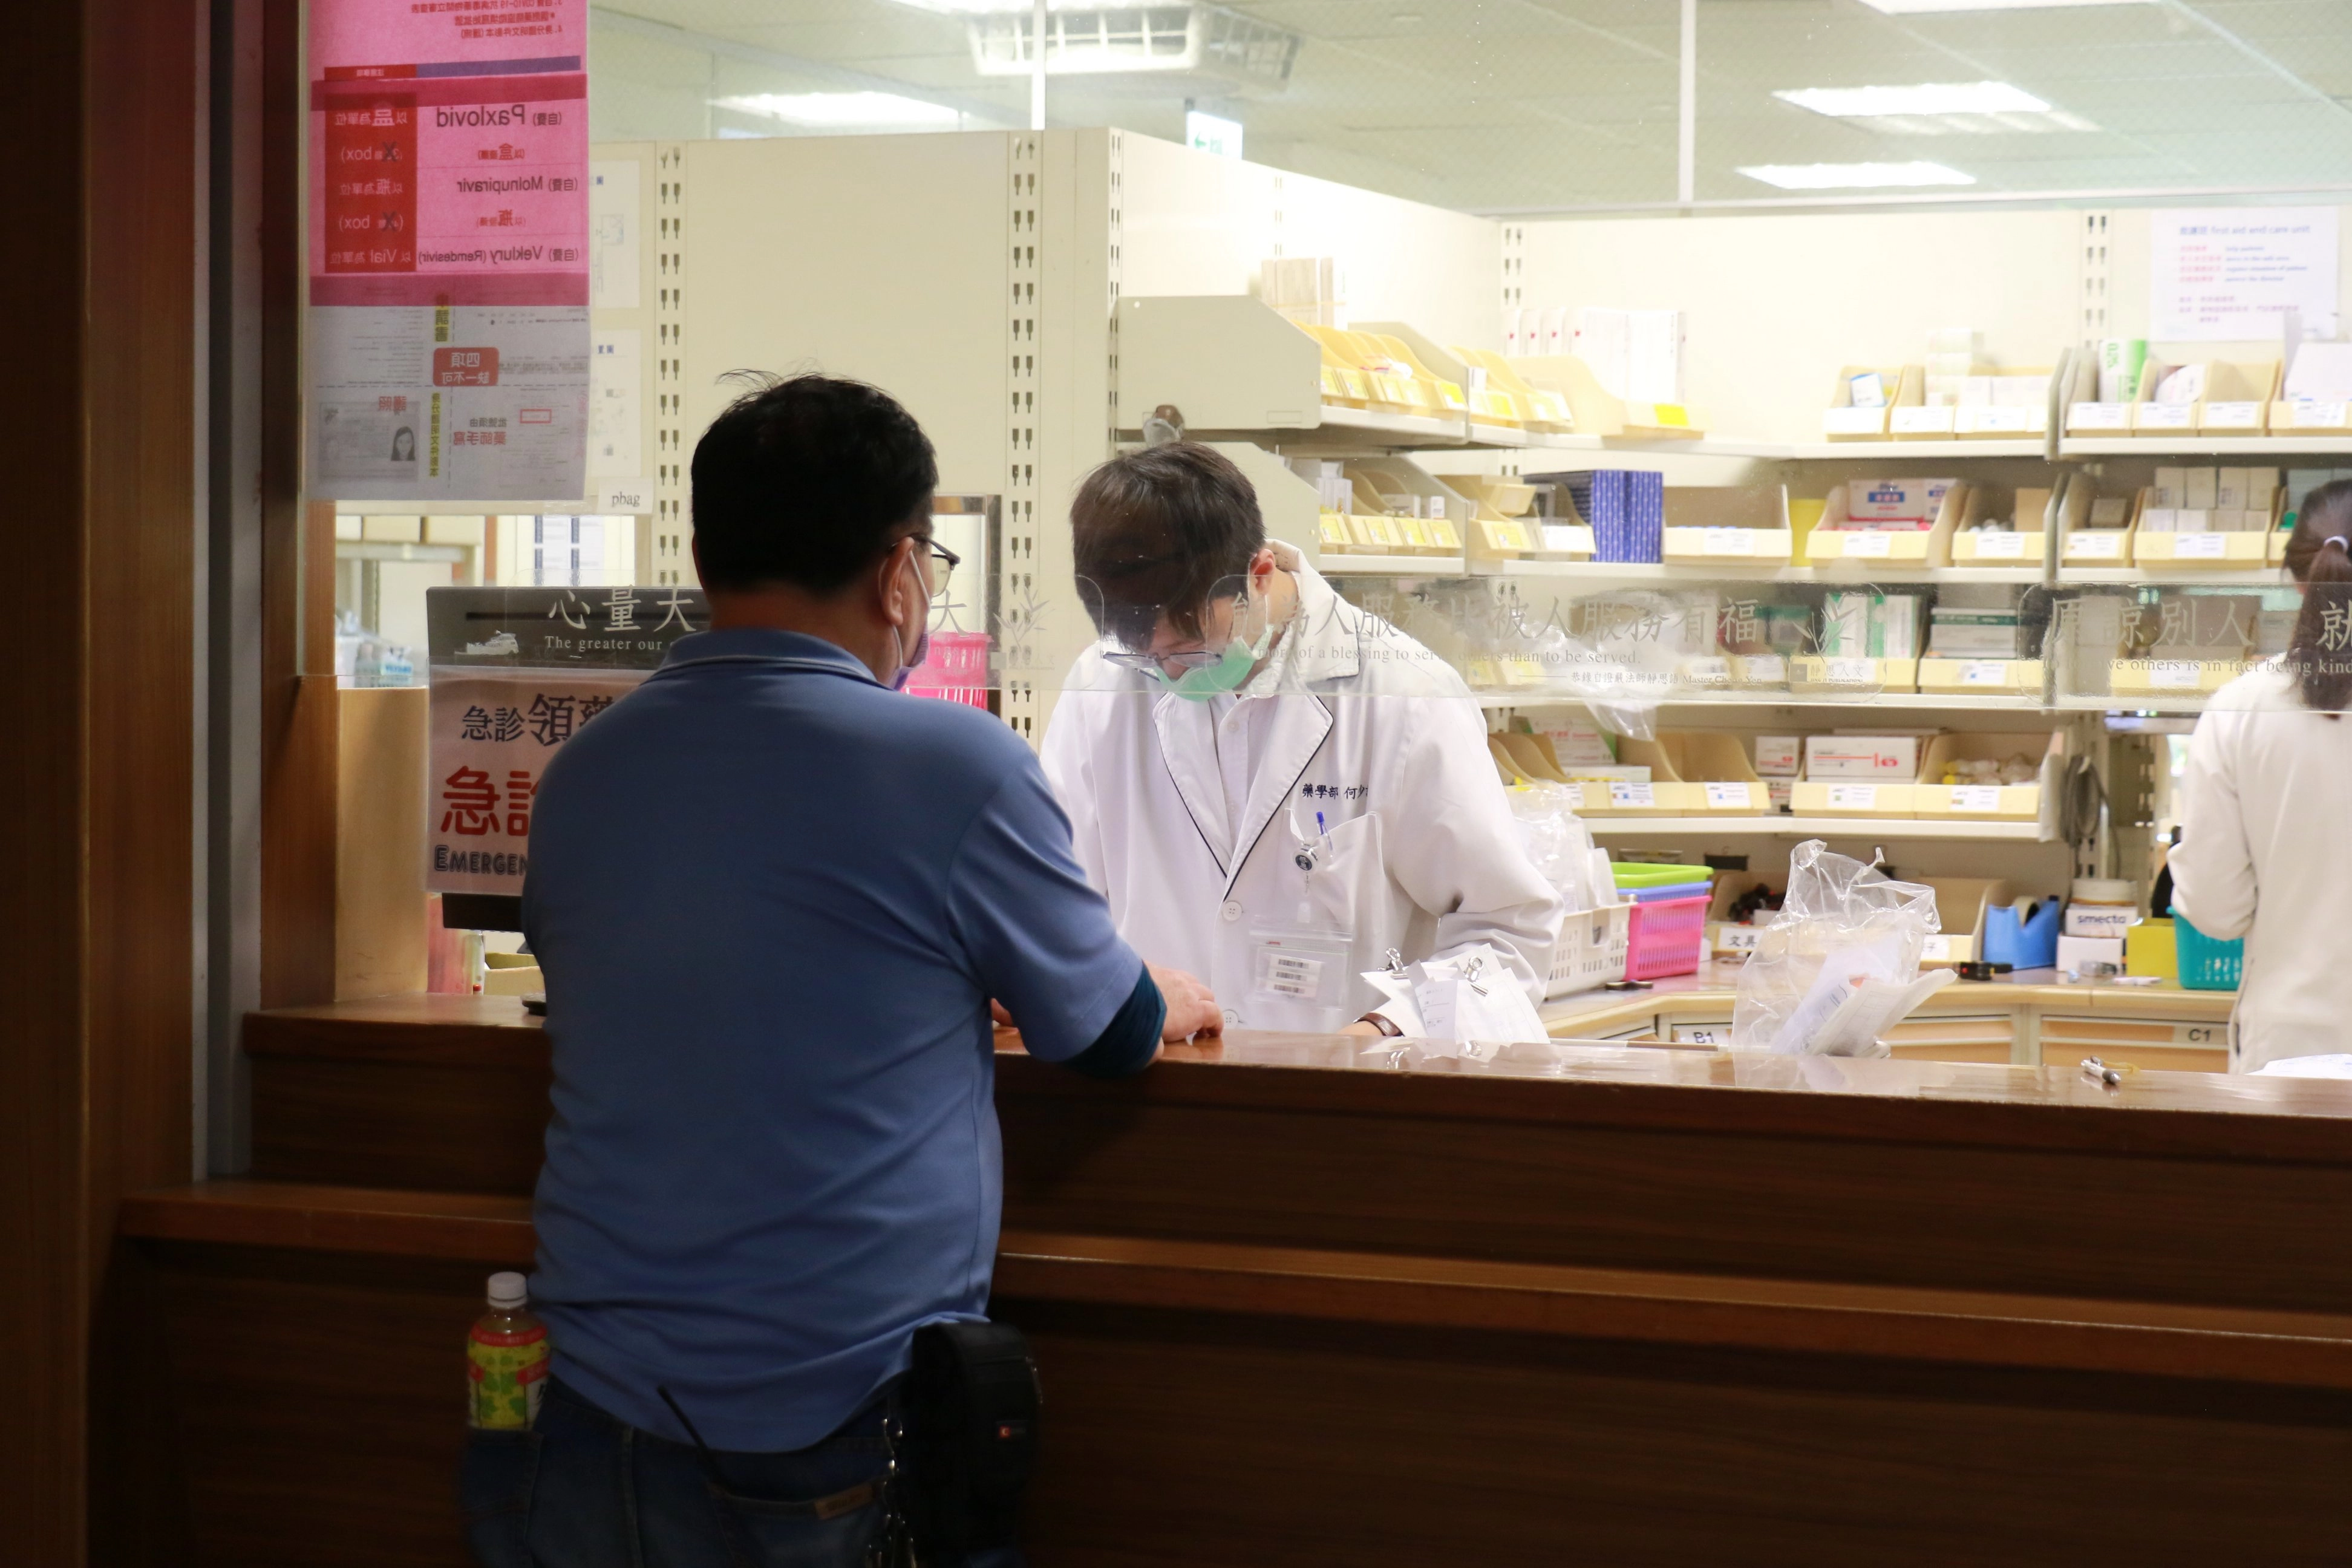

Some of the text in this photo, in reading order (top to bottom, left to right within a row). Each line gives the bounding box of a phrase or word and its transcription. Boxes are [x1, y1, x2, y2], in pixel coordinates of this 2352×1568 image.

[612, 491, 640, 507] pbag
[548, 584, 696, 632] 心量大
[545, 636, 662, 652] The greater our
[1299, 645, 1313, 659] of
[1319, 649, 1326, 659] a
[1331, 646, 1390, 663] blessing
[1396, 647, 1409, 660] to
[1508, 650, 1540, 662] than
[1546, 652, 1560, 662] to
[1566, 650, 1582, 663] be
[1588, 650, 1641, 664] served.
[2130, 656, 2180, 671] others
[2187, 659, 2200, 671] is
[2207, 659, 2221, 671] in
[2229, 658, 2258, 673] fact
[2266, 658, 2311, 676] being
[1683, 675, 1713, 684] Master
[1745, 677, 1762, 686] Yen
[1302, 783, 1339, 800] 藥學部
[2077, 914, 2126, 924] smecta
[1728, 935, 1757, 947] 文具
[1693, 1031, 1713, 1044] B1
[2189, 1029, 2212, 1042] C1
